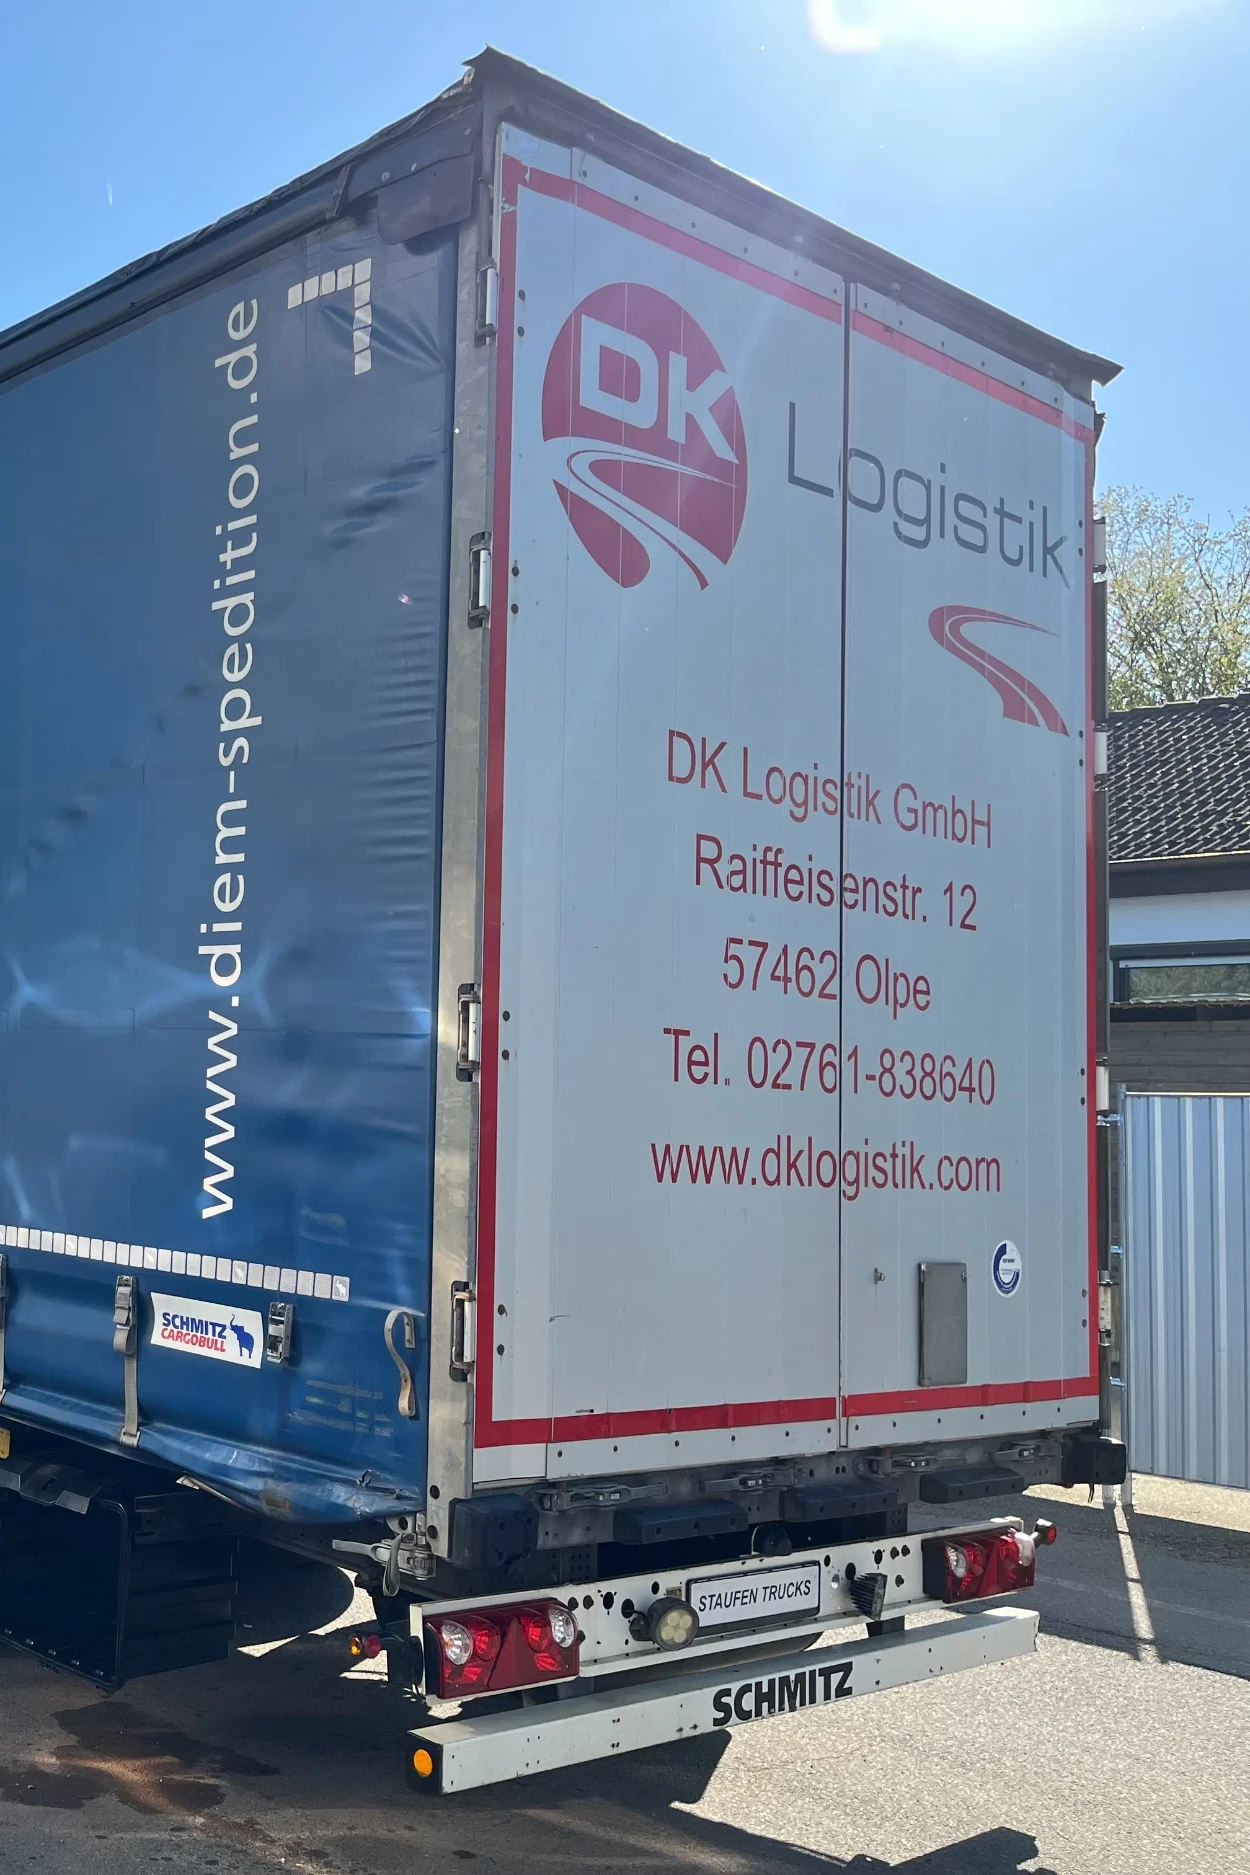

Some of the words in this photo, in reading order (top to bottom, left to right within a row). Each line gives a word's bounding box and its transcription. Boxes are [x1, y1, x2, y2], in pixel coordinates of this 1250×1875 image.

[579, 313, 738, 464] DK
[787, 401, 1071, 588] Logistik
[201, 298, 263, 1219] www.diem-spedition.de
[667, 729, 728, 793] DK
[742, 746, 882, 826] Logistik
[894, 783, 993, 849] GmbH
[694, 833, 928, 923] Raiffeisenstr.
[943, 880, 978, 931] 12
[723, 937, 838, 1000] 57462
[855, 953, 932, 1020] Olpe
[663, 1027, 731, 1086] Tel.
[747, 1036, 996, 1105] 02761-838640
[651, 1135, 1001, 1201] www.dklogistik.com
[161, 1312, 227, 1340] SCHMITZ
[161, 1327, 226, 1352] CARGOBULL
[698, 1587, 759, 1612] STAUFEN
[762, 1579, 812, 1603] TRUCKS
[712, 1660, 854, 1727] SCHMITZ
